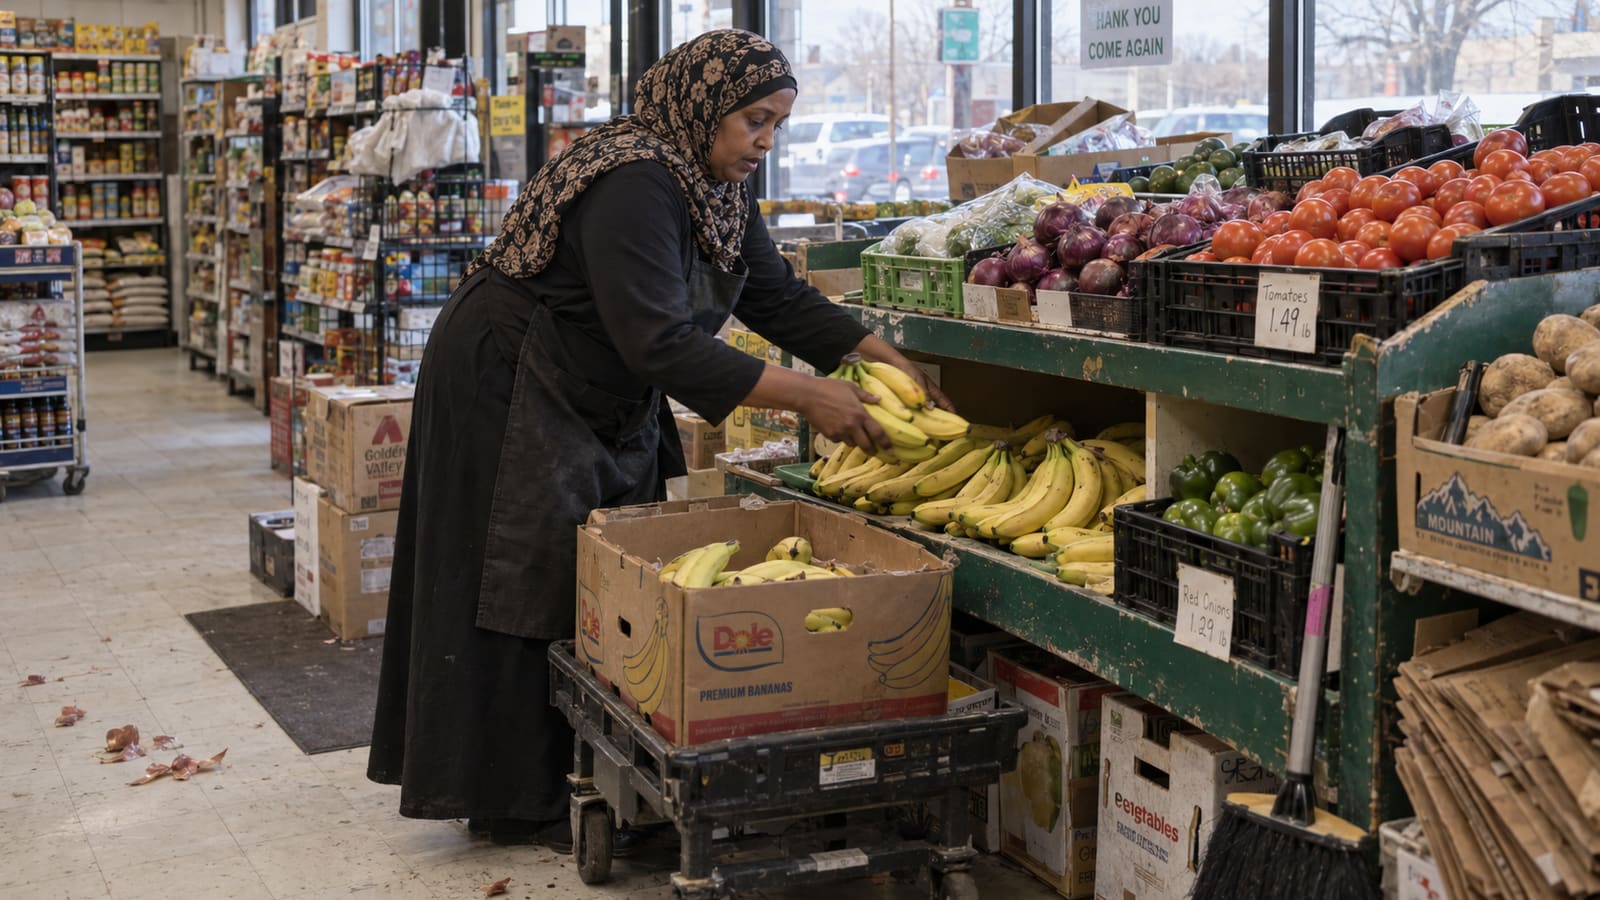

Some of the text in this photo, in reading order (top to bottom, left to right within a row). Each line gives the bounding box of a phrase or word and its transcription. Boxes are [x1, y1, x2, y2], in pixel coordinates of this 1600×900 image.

[1089, 5, 1161, 31] HANK YOU
[1088, 36, 1164, 60] COME AGAIN
[1262, 283, 1309, 303] Tomatoes
[1269, 307, 1311, 338] 1.49 lb
[1427, 512, 1495, 546] MOUNTAIN
[1183, 584, 1199, 607] Red
[581, 598, 600, 640] Dole
[1190, 612, 1228, 647] 1.29 lb
[713, 622, 774, 653] Dole
[699, 681, 793, 702] PREMIUM BANANAS
